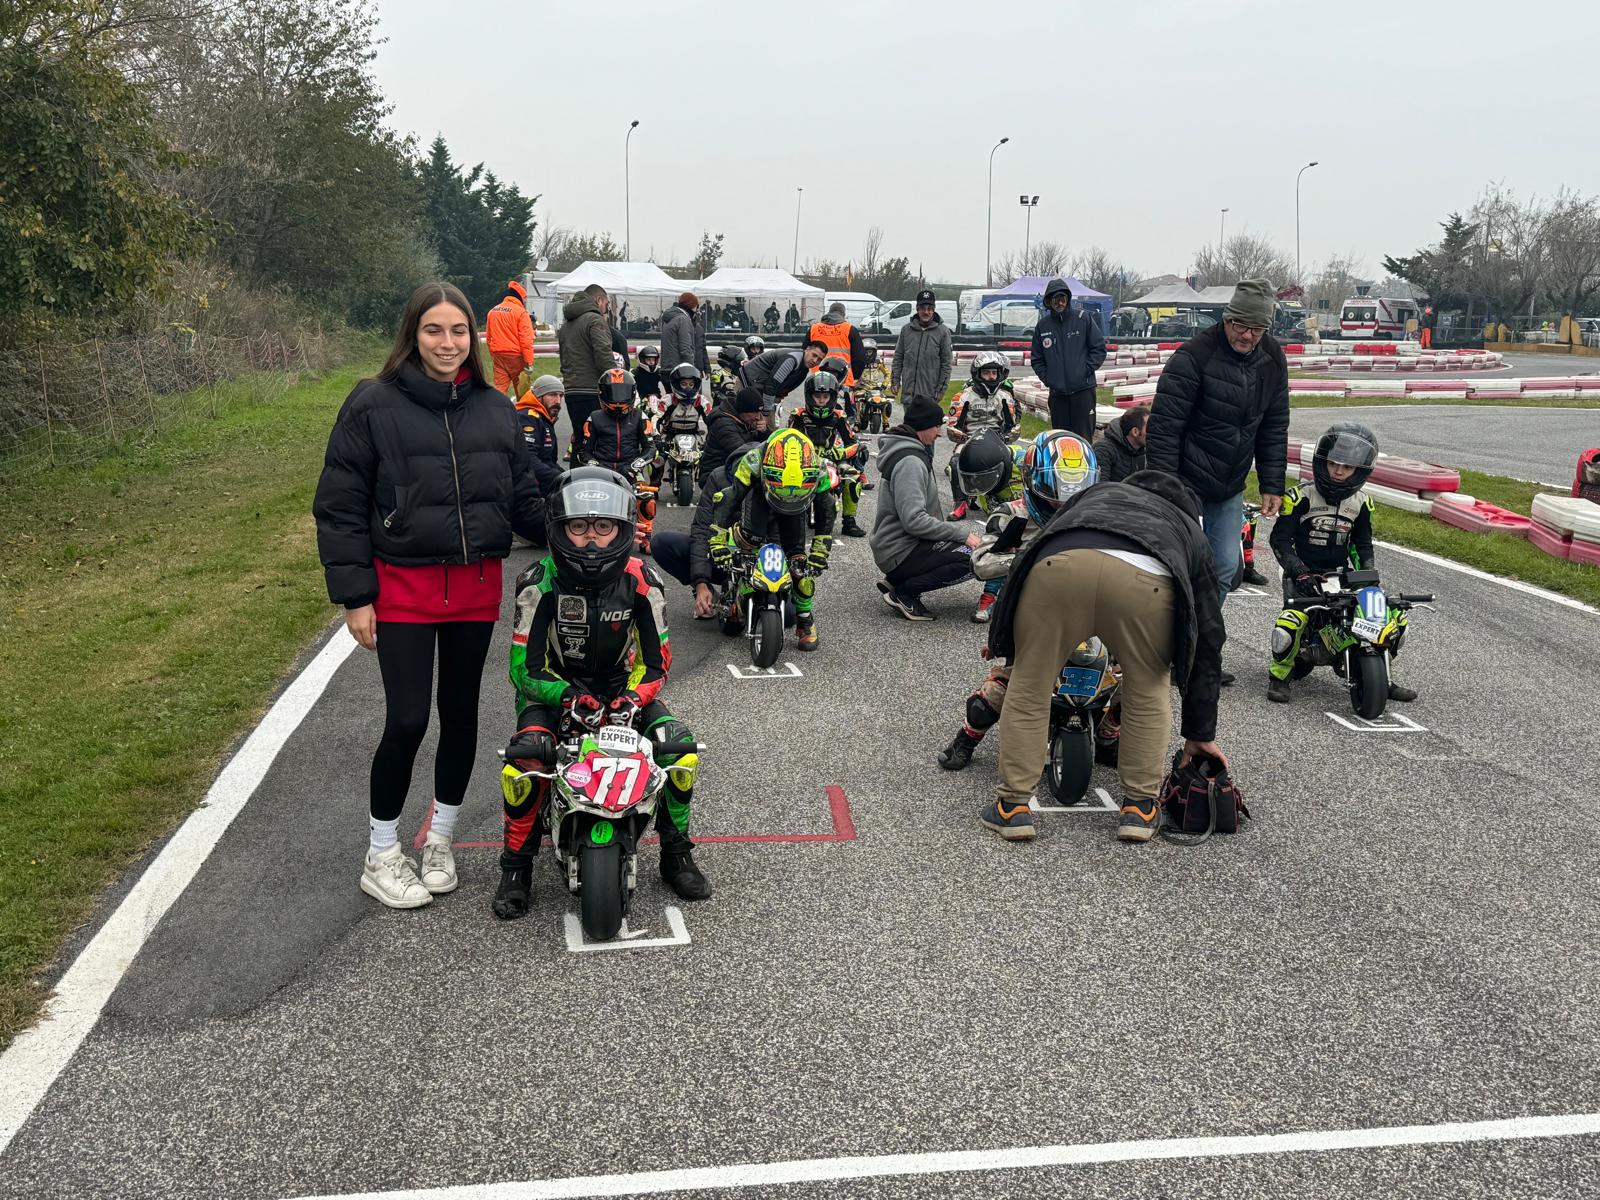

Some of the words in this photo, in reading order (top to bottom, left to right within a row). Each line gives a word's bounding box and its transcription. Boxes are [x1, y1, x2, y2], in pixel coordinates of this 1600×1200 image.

[764, 548, 783, 573] 88
[1366, 591, 1386, 618] 10
[600, 609, 632, 621] NOE
[1354, 622, 1380, 635] EXPERT
[600, 732, 637, 745] EXPERT
[592, 757, 642, 805] 77
